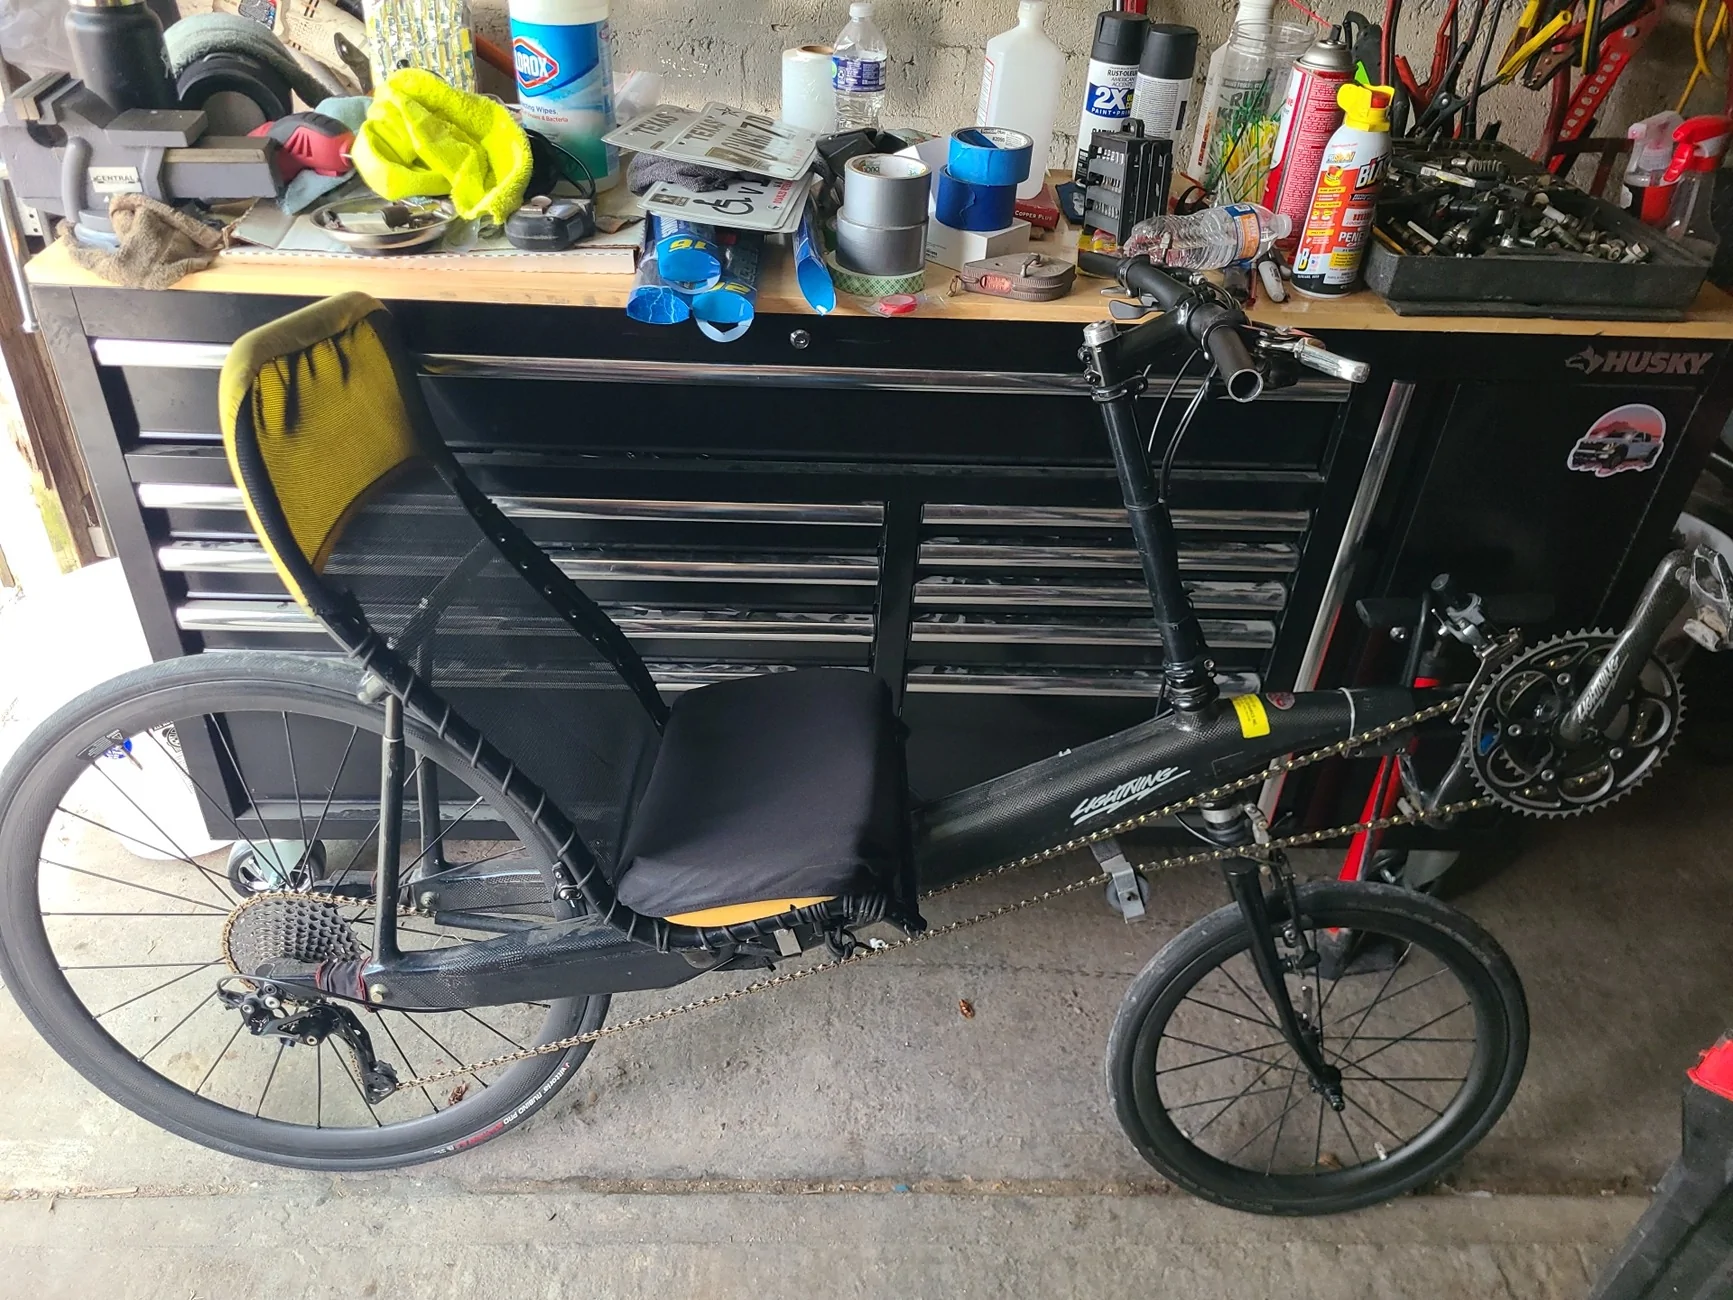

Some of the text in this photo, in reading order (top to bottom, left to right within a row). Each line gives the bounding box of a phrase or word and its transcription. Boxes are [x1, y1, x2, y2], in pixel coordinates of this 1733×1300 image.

[1093, 86, 1129, 109] 2X
[632, 113, 680, 136] TEXAS
[684, 117, 728, 141] TEXAS
[1014, 210, 1036, 220] COPPER
[1601, 350, 1713, 374] HUSKY
[1572, 655, 1619, 723] LIGHTNING
[1071, 767, 1181, 820] LIGHTNING
[545, 1067, 568, 1094] vittoria
[503, 1092, 542, 1125] RUBINO PRO
